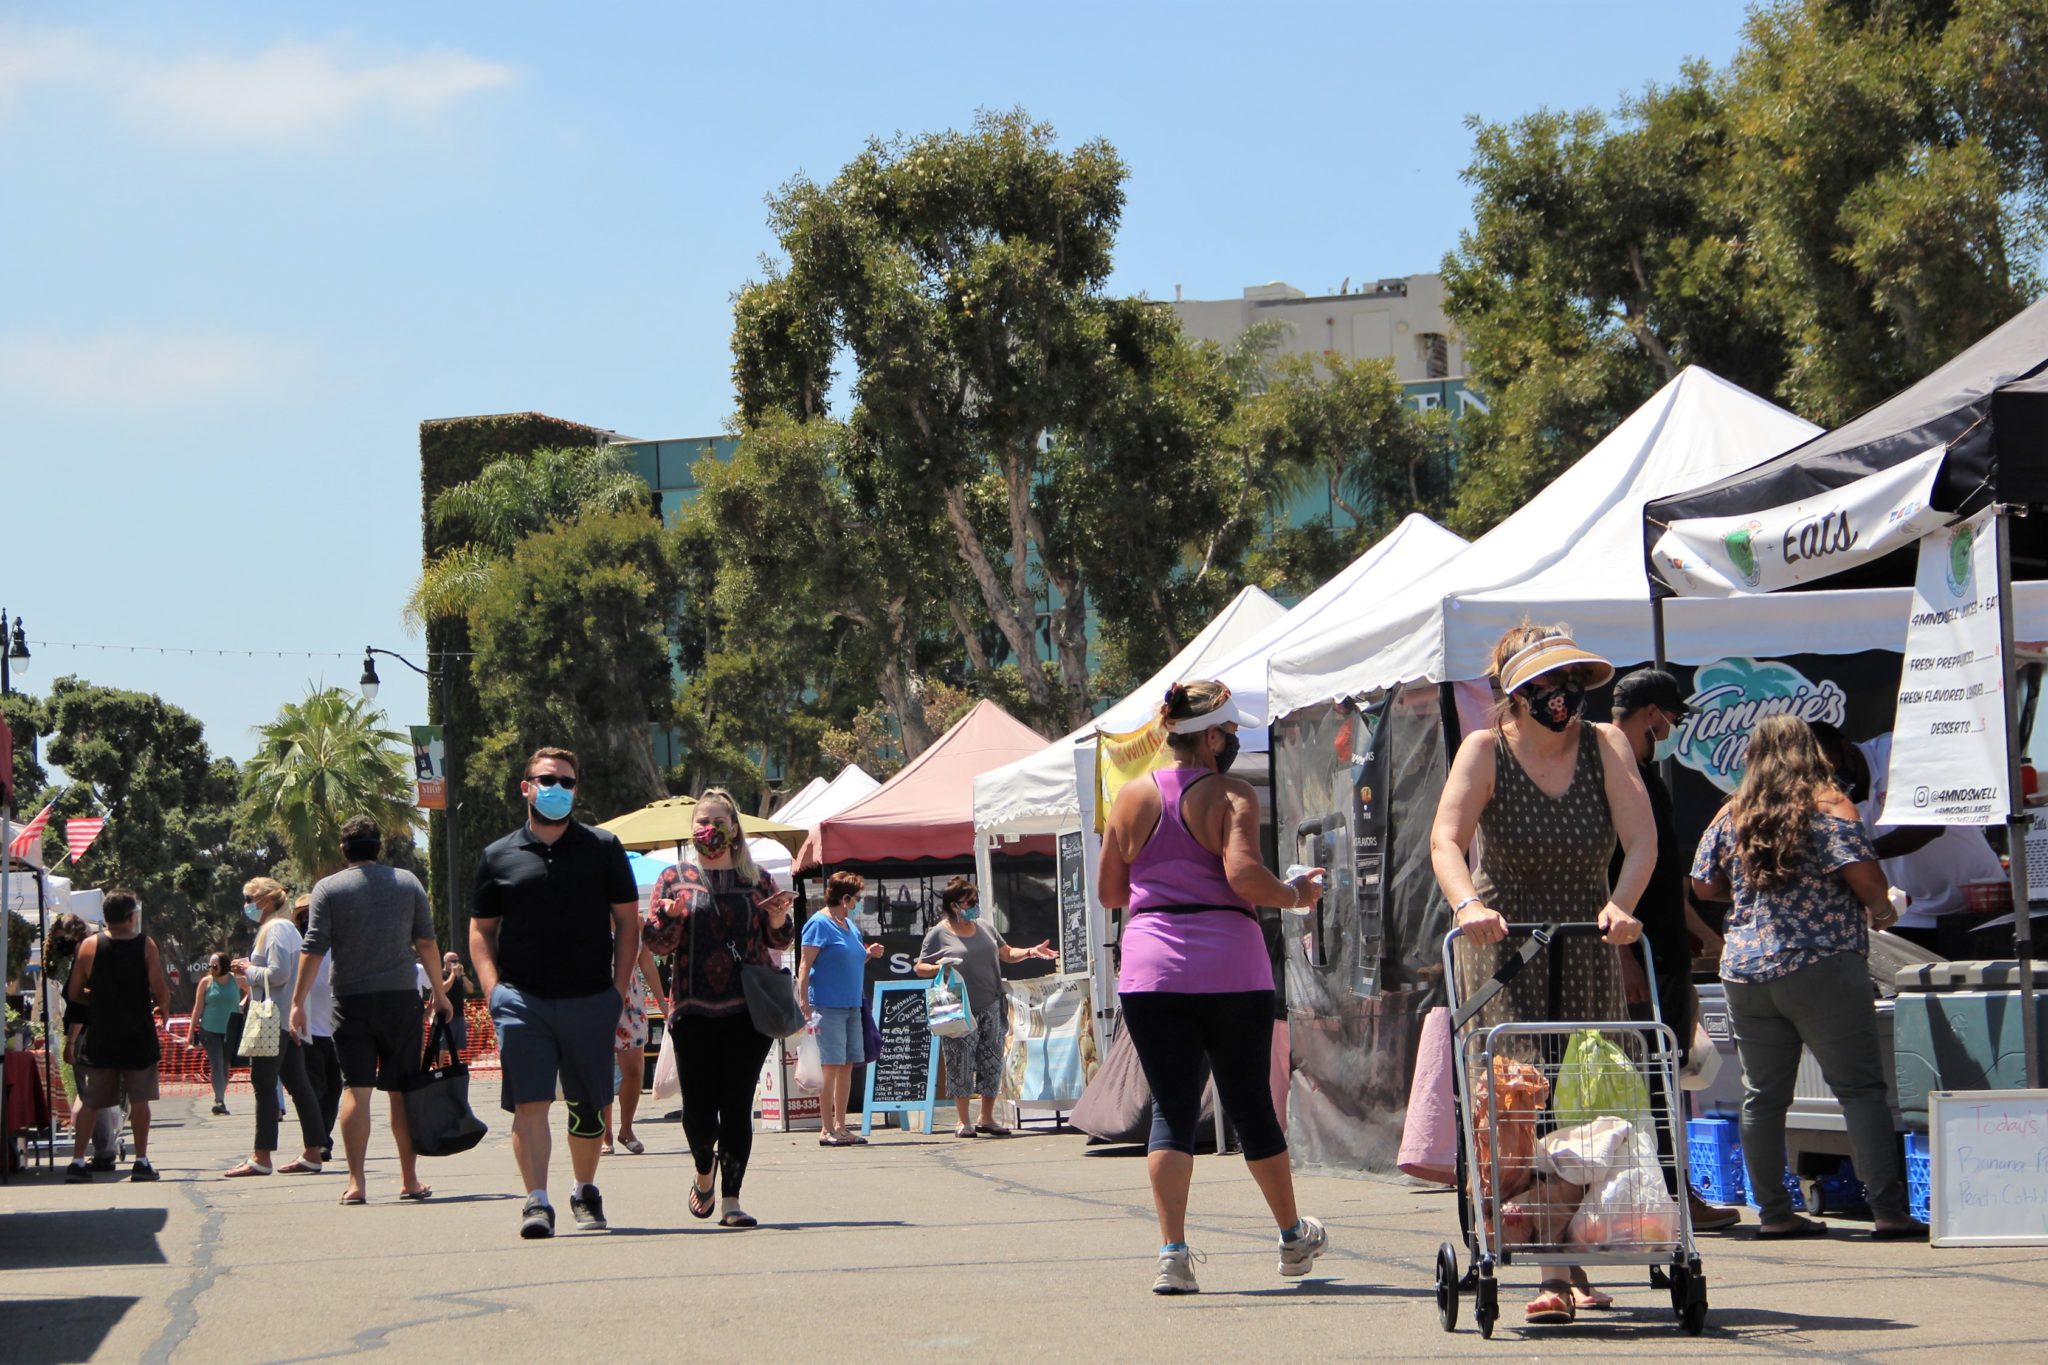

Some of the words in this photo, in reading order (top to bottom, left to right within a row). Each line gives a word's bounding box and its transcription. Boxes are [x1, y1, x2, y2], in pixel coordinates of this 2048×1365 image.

[1782, 505, 1859, 564] Eats
[1910, 658, 1935, 672] FRESH
[1899, 690, 1923, 705] FRESH
[1924, 687, 1965, 703] FLAVORED
[1677, 684, 1842, 757] Tammie's
[1930, 720, 1971, 735] DESSERTS
[1930, 786, 1998, 803] @4MNDSWELL
[1967, 1104, 2039, 1137] Today's
[1957, 1145, 2026, 1178] Banana
